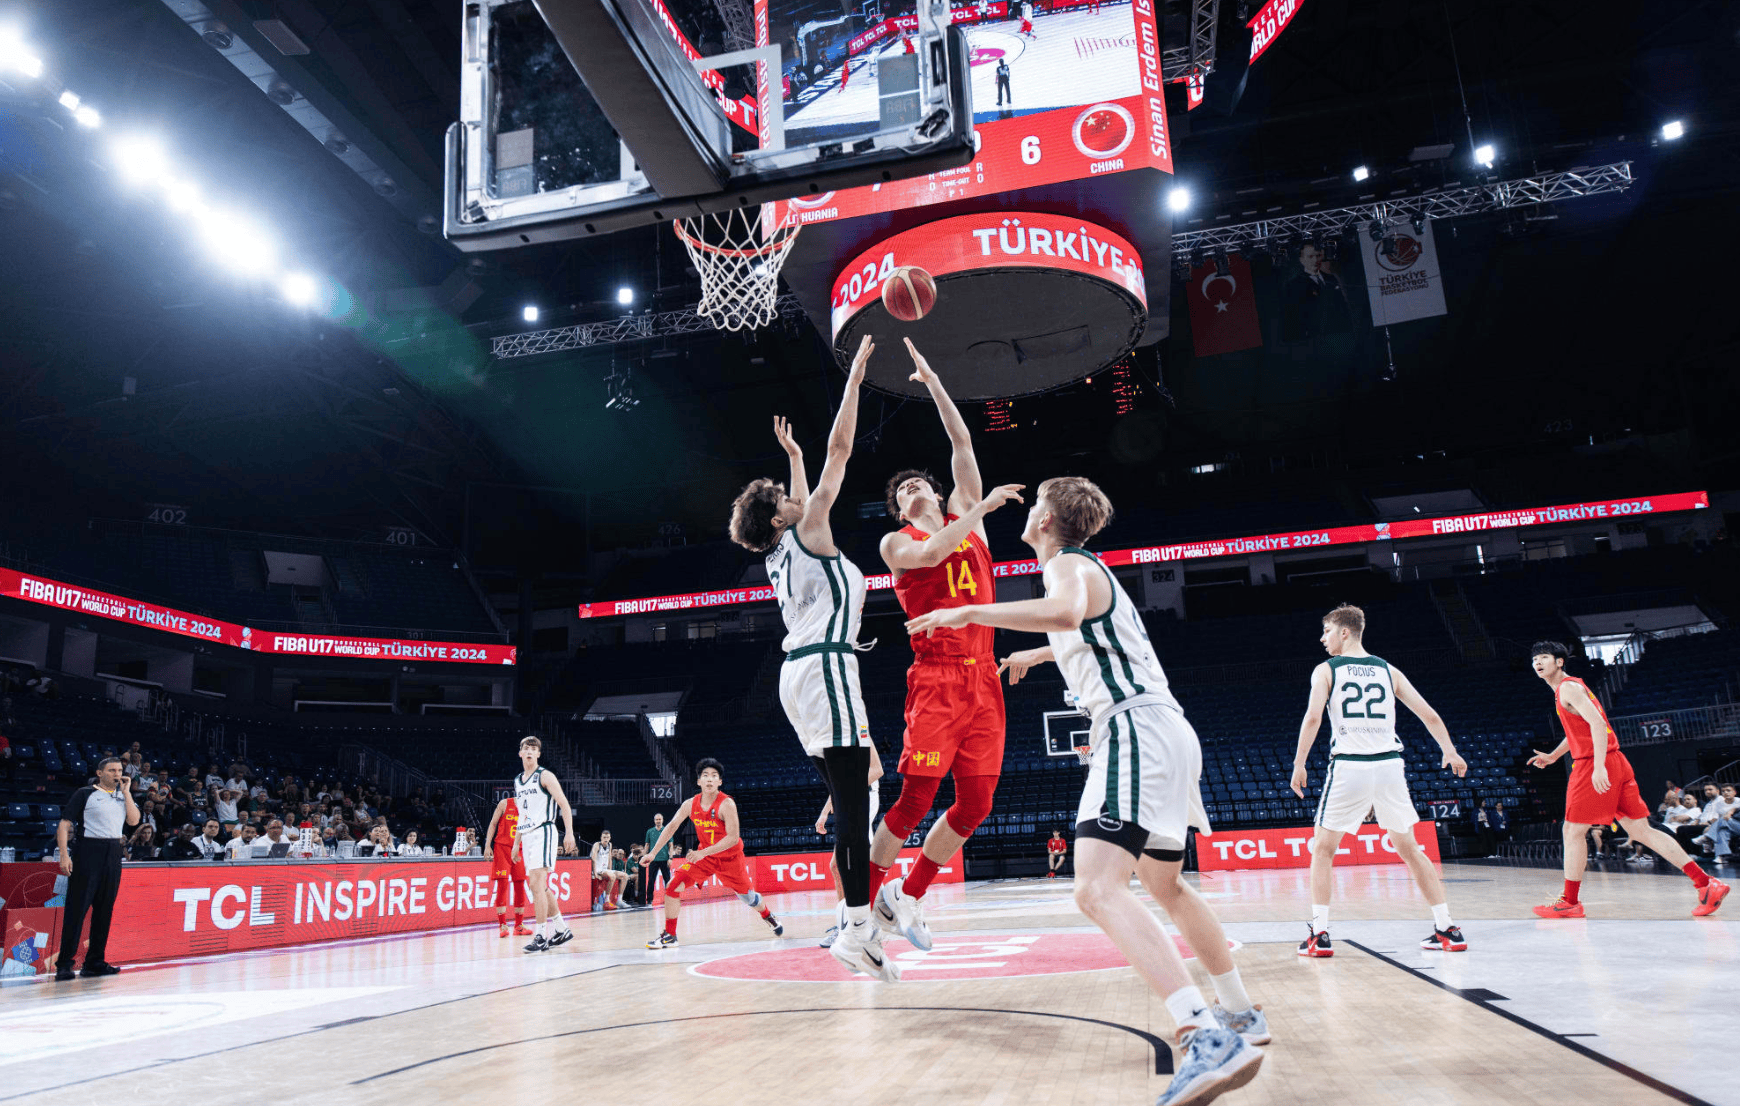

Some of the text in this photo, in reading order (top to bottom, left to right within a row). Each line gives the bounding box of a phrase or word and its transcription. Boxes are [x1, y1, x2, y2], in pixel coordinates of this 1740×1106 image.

[950, 11, 973, 19] TCL
[876, 24, 887, 35] TCL
[894, 18, 918, 27] TCL
[1250, 18, 1276, 59] RLD
[1140, 22, 1159, 91] Erdem
[1150, 98, 1167, 159] Sinan
[1021, 135, 1042, 165] 6
[1090, 158, 1124, 174] CHINA
[942, 177, 970, 187] TIME-OUT
[787, 207, 838, 225] LIHUANIA
[972, 218, 1126, 275] TÜRKİYE
[840, 252, 898, 309] 2024
[1380, 270, 1427, 285] TÜRKİYE
[149, 509, 186, 525] 402
[1536, 500, 1653, 523] TÜRKİYE 2024
[1432, 515, 1488, 534] FIBA U17
[1490, 515, 1536, 528] WORLD CUP
[386, 531, 416, 546] 401
[1226, 533, 1330, 553] TÜRKİYE 2024
[1132, 546, 1183, 563] FIBA U17
[1183, 547, 1225, 558] WORLD CUP
[865, 575, 890, 590] FIBA
[946, 560, 977, 597] 14
[20, 578, 81, 607] FIBA U17
[693, 590, 746, 606] TÜRKİYE
[81, 598, 126, 617] WORLD CUP
[615, 599, 658, 615] FIBA U17
[658, 600, 692, 610] WORLD CUP
[127, 604, 222, 638] TÜRKİYE 2024
[274, 636, 334, 653] FIBA U17
[334, 645, 380, 655] WORLD CUP
[382, 641, 487, 660] TÜRKİYE 2024
[1347, 665, 1376, 677] POCIUS
[1341, 681, 1386, 719] 22
[1641, 722, 1672, 738] 123
[652, 787, 673, 799] 126
[523, 799, 528, 809] 4
[1430, 803, 1461, 818] 124
[693, 818, 718, 828] CHINA
[704, 829, 715, 844] 7
[904, 833, 920, 846] 25
[1212, 839, 1277, 860] TCL
[771, 862, 825, 881] TCL
[173, 872, 571, 932] TCL INSPIRE GRESS
